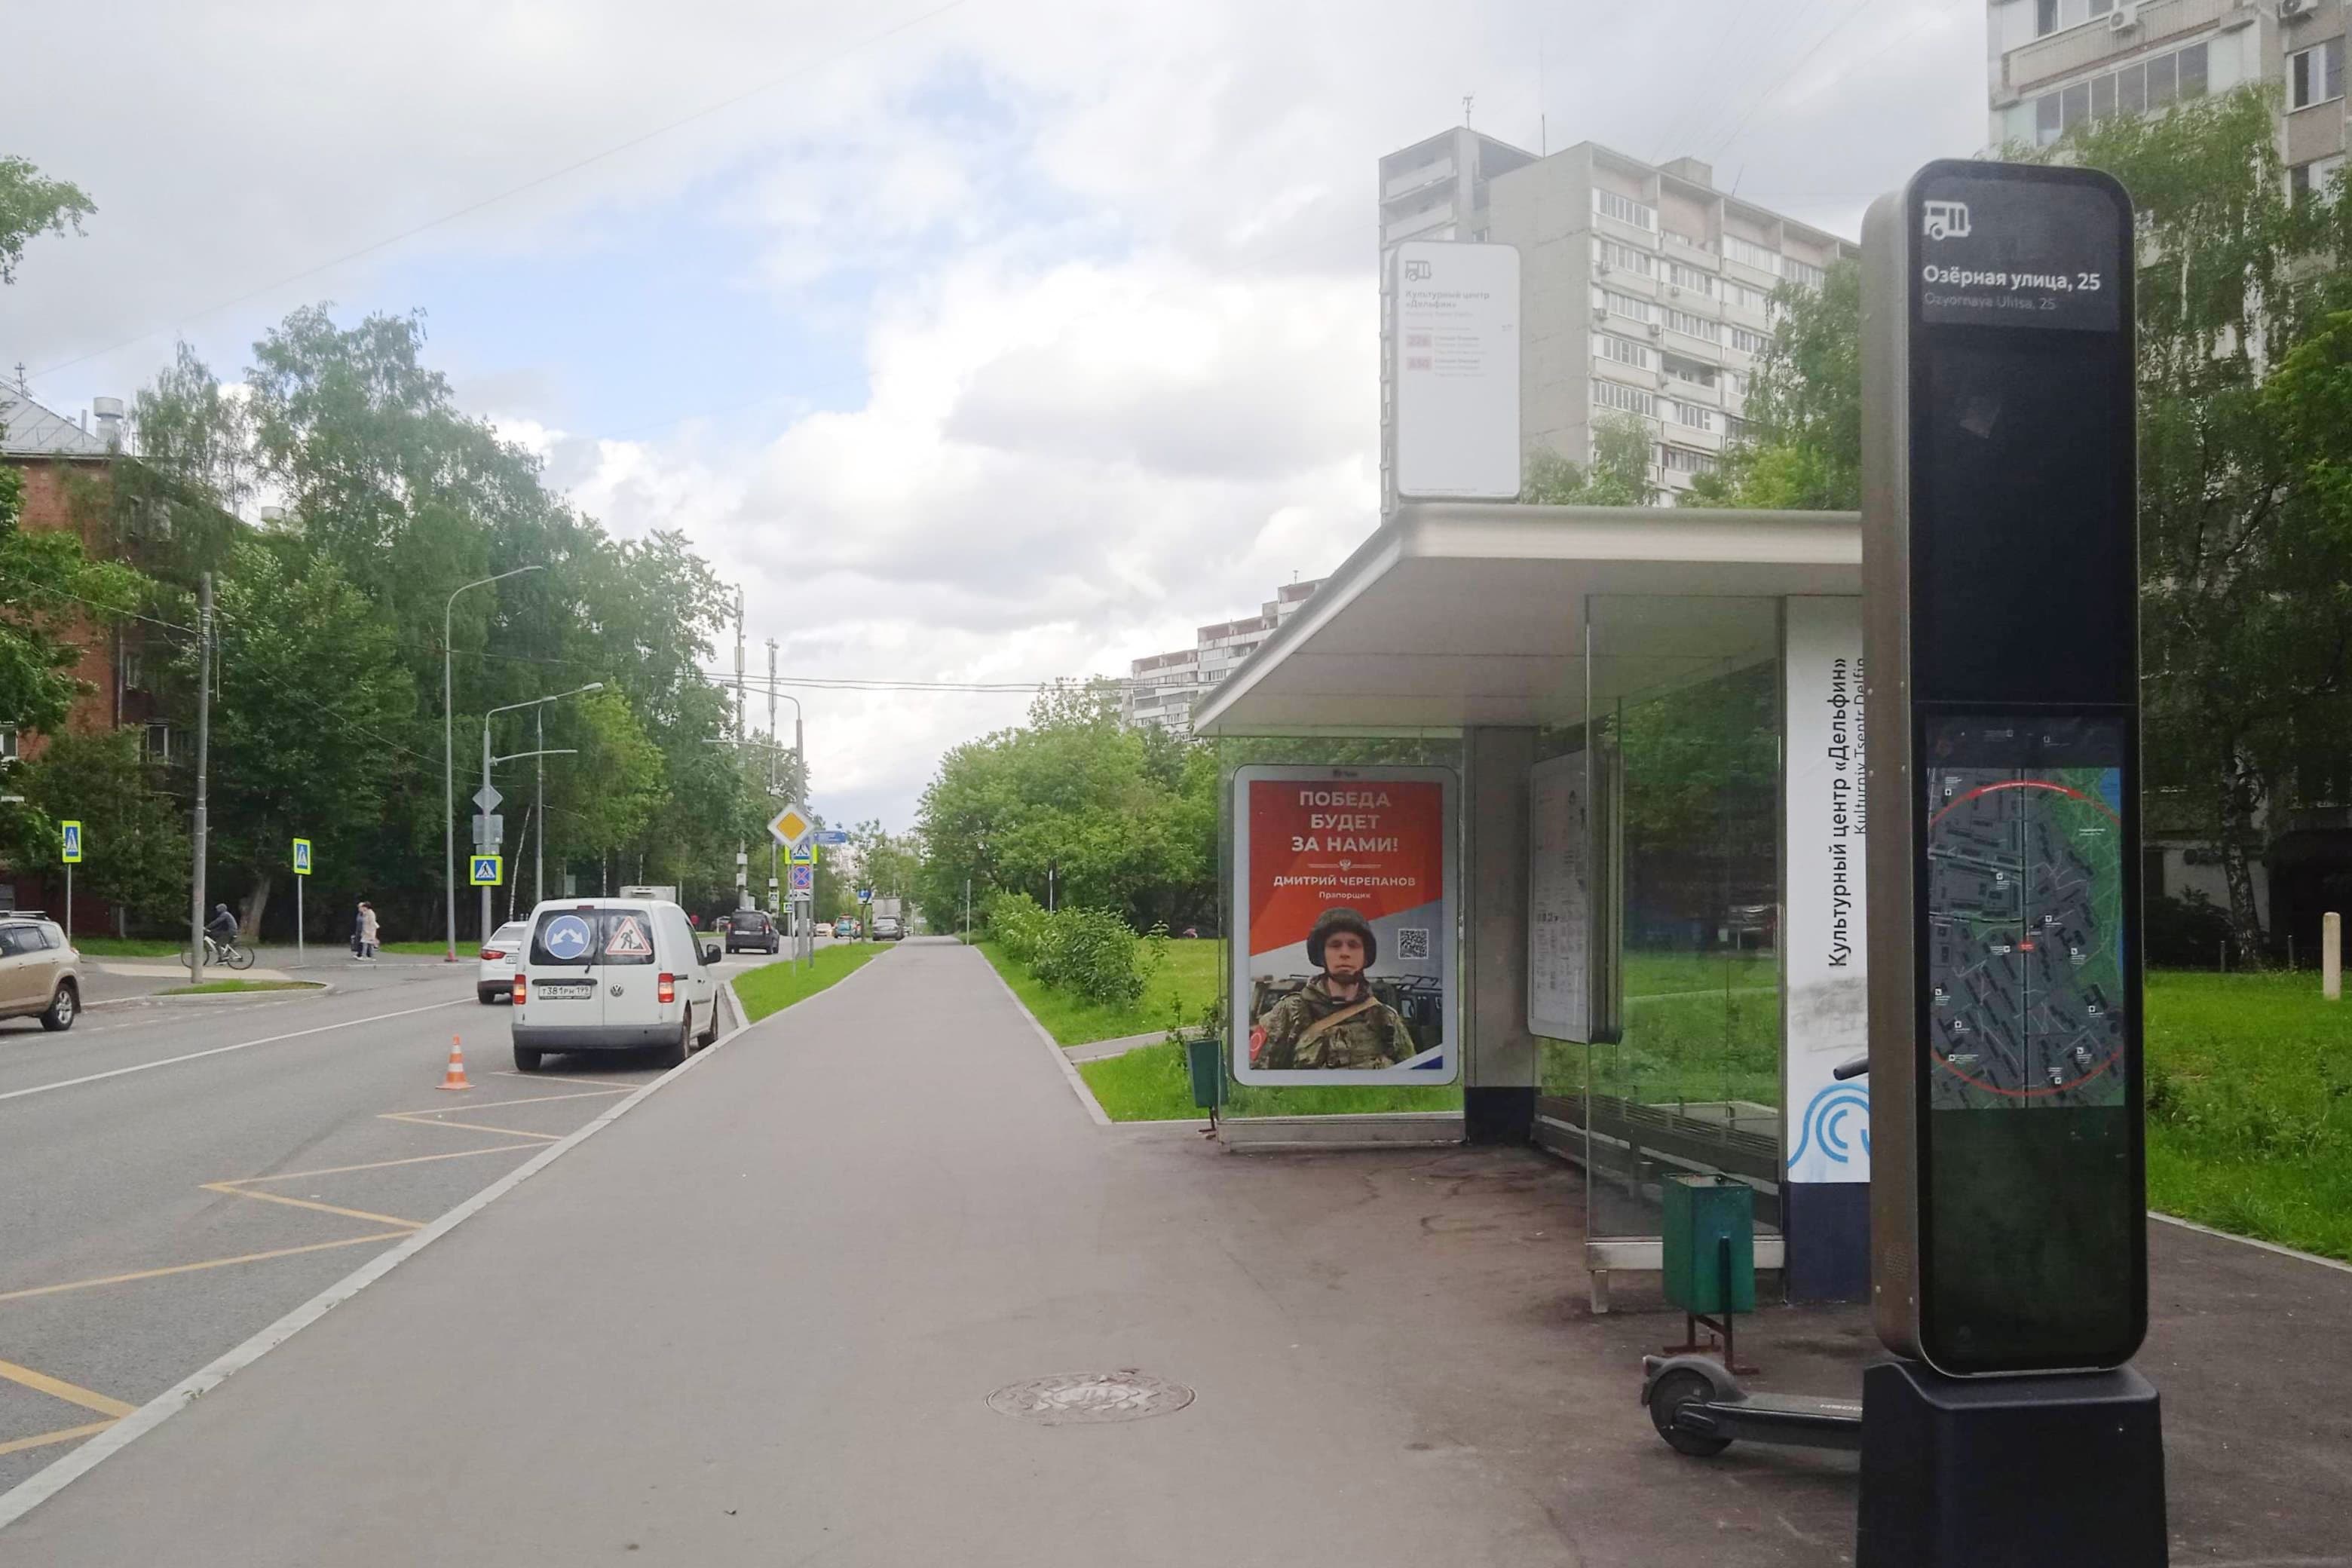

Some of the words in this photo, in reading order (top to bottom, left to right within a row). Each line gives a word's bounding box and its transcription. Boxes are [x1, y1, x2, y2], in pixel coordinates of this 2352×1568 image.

[1924, 265, 2007, 287] Озёрная
[2011, 273, 2073, 292] улица,
[2077, 273, 2101, 291] 25
[2038, 297, 2057, 310] 25
[1827, 657, 1851, 770] «Дельфин»
[1299, 791, 1392, 809] ПОБЕДА
[1832, 778, 1851, 838] центр
[1310, 814, 1380, 831] БУДЕТ
[1291, 836, 1320, 852] ЗА
[1327, 837, 1398, 853] НАМИ!
[1273, 874, 1337, 887] ДМИТРИЙ
[1340, 877, 1416, 887] ЧЕРЕПАНОВ
[1318, 890, 1371, 900] Прапорщик
[1828, 845, 1851, 967] Культурный
